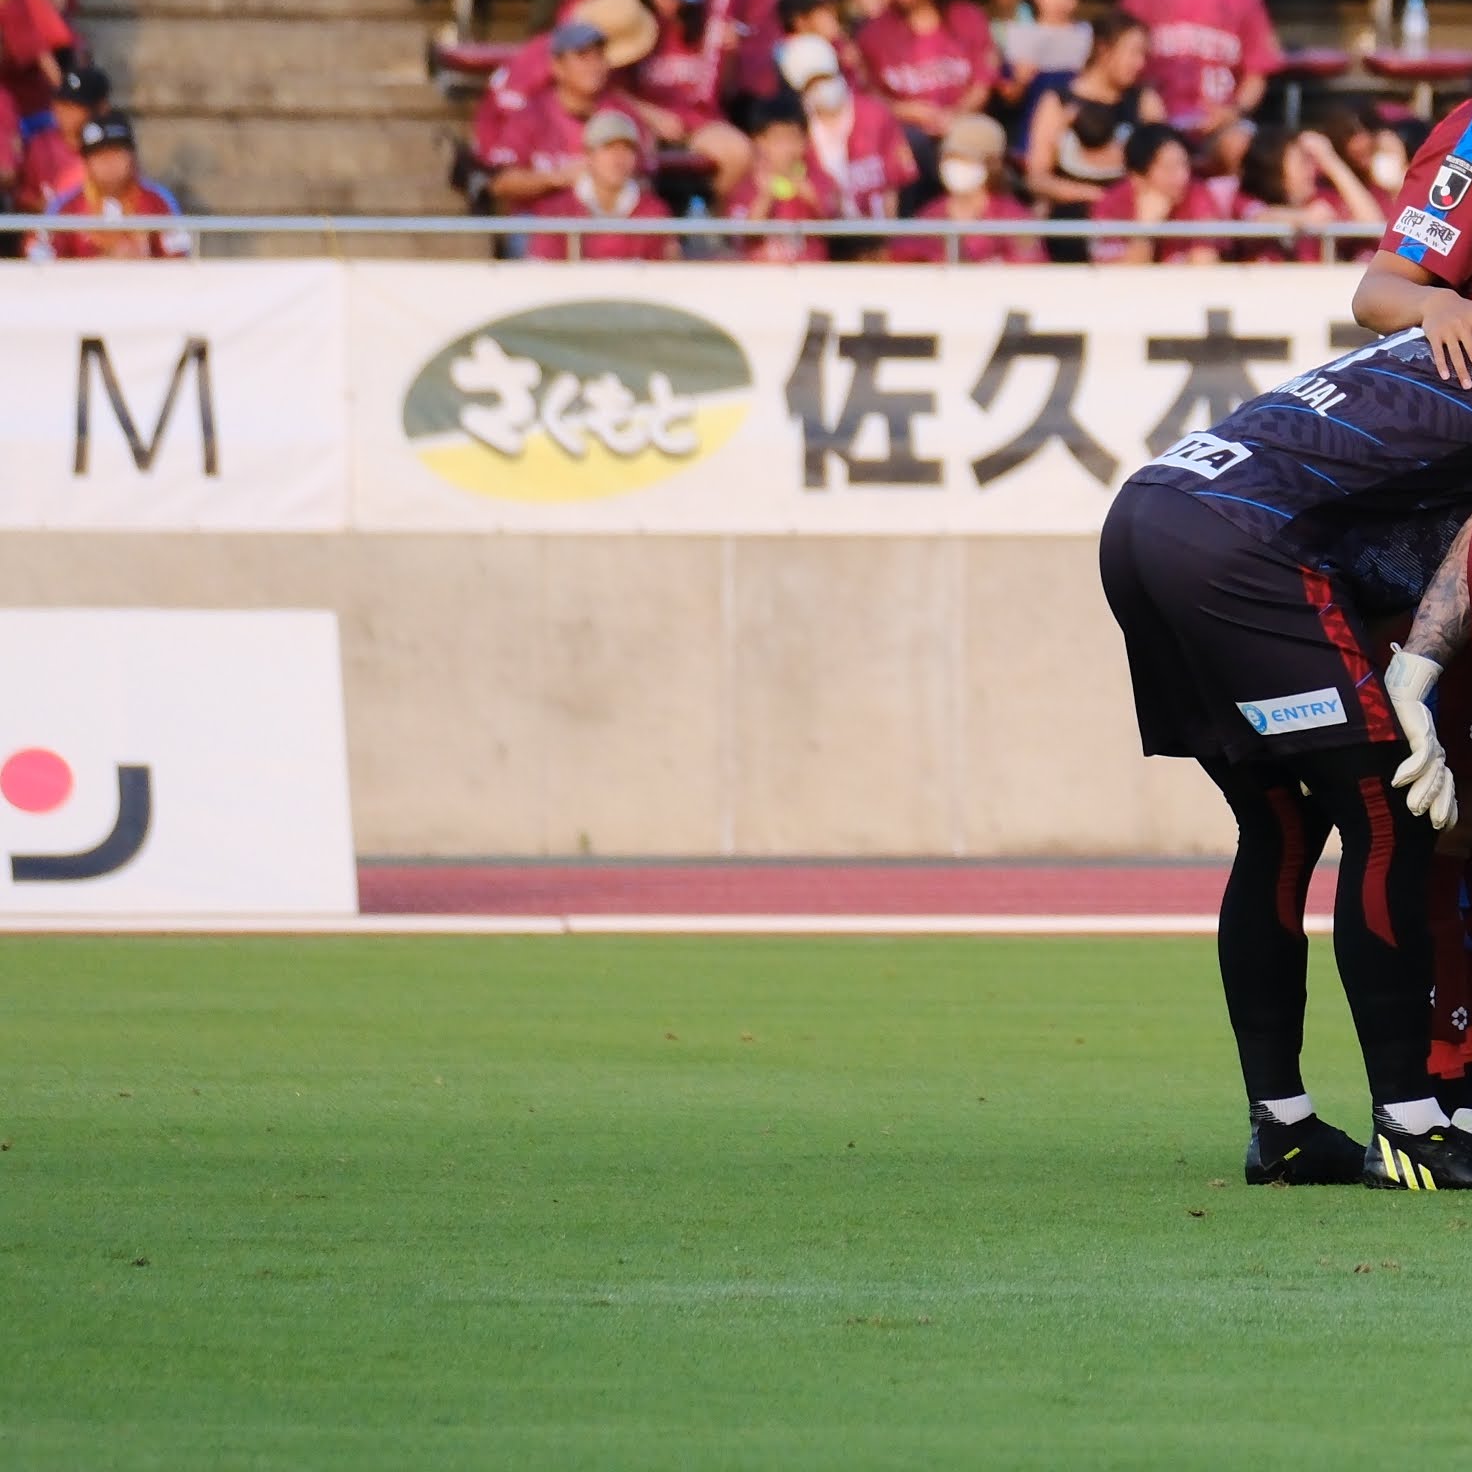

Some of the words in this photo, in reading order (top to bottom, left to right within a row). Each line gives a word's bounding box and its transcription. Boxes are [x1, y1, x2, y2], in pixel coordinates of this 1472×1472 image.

[73, 334, 221, 477] M
[448, 333, 704, 460] さくもと
[784, 308, 1382, 489] 佐久本
[1271, 698, 1339, 723] ENTRY
